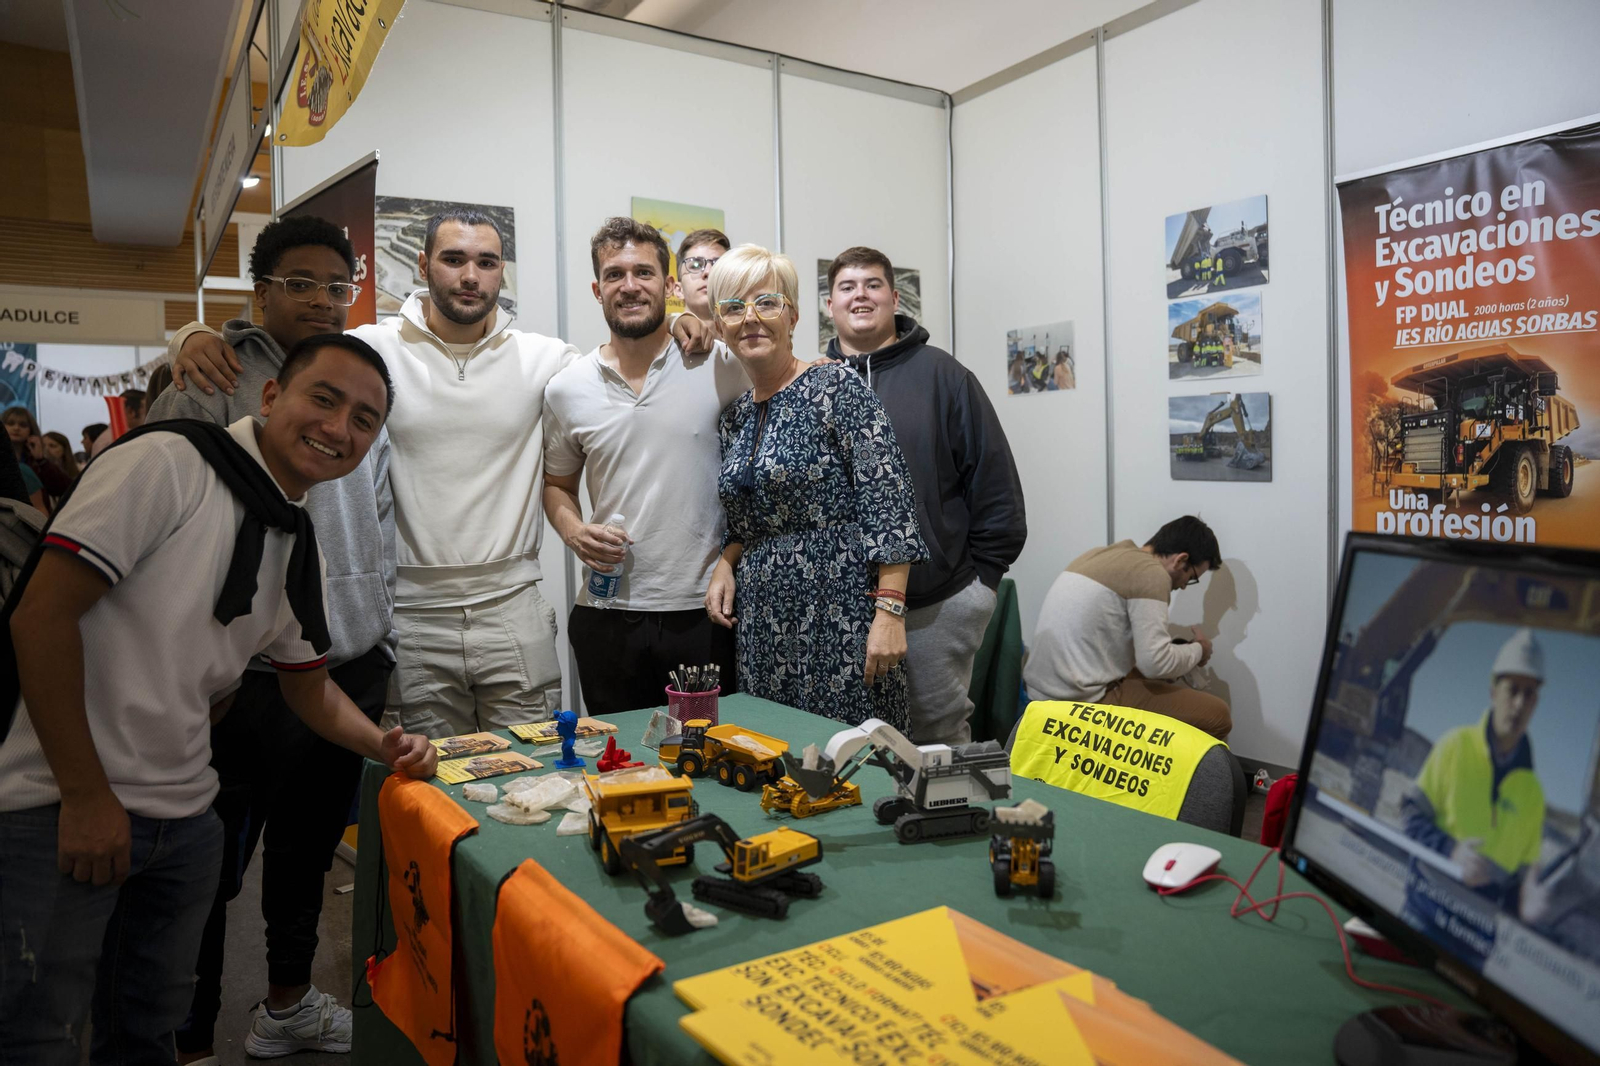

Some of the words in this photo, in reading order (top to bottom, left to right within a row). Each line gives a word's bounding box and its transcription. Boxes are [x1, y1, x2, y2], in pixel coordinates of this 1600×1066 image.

[1374, 187, 1492, 234] Técnico
[1500, 179, 1546, 211] en
[1375, 209, 1600, 267] Excavaciones
[1374, 279, 1390, 307] y
[1394, 255, 1536, 297] Sondeos
[1395, 328, 1421, 345] IES
[1424, 321, 1453, 343] RÍO
[1455, 318, 1513, 341] AGUAS
[1514, 310, 1599, 335] SORBAS
[1396, 306, 1417, 324] FP
[1421, 299, 1469, 322] DUAL
[1474, 303, 1497, 315] 2000
[1499, 301, 1525, 314] horas
[1527, 298, 1538, 311] (2
[1538, 295, 1569, 308] años)
[1389, 489, 1429, 510] Una
[1376, 502, 1536, 543] profesión
[1069, 703, 1146, 740] TÉCNICO
[1147, 728, 1176, 747] EN
[1042, 718, 1173, 776] EXCAVACIONES
[1054, 746, 1068, 764] Y
[1070, 754, 1150, 797] SONDEOS
[929, 797, 968, 807] LIEBHERR
[764, 956, 805, 979] EXC
